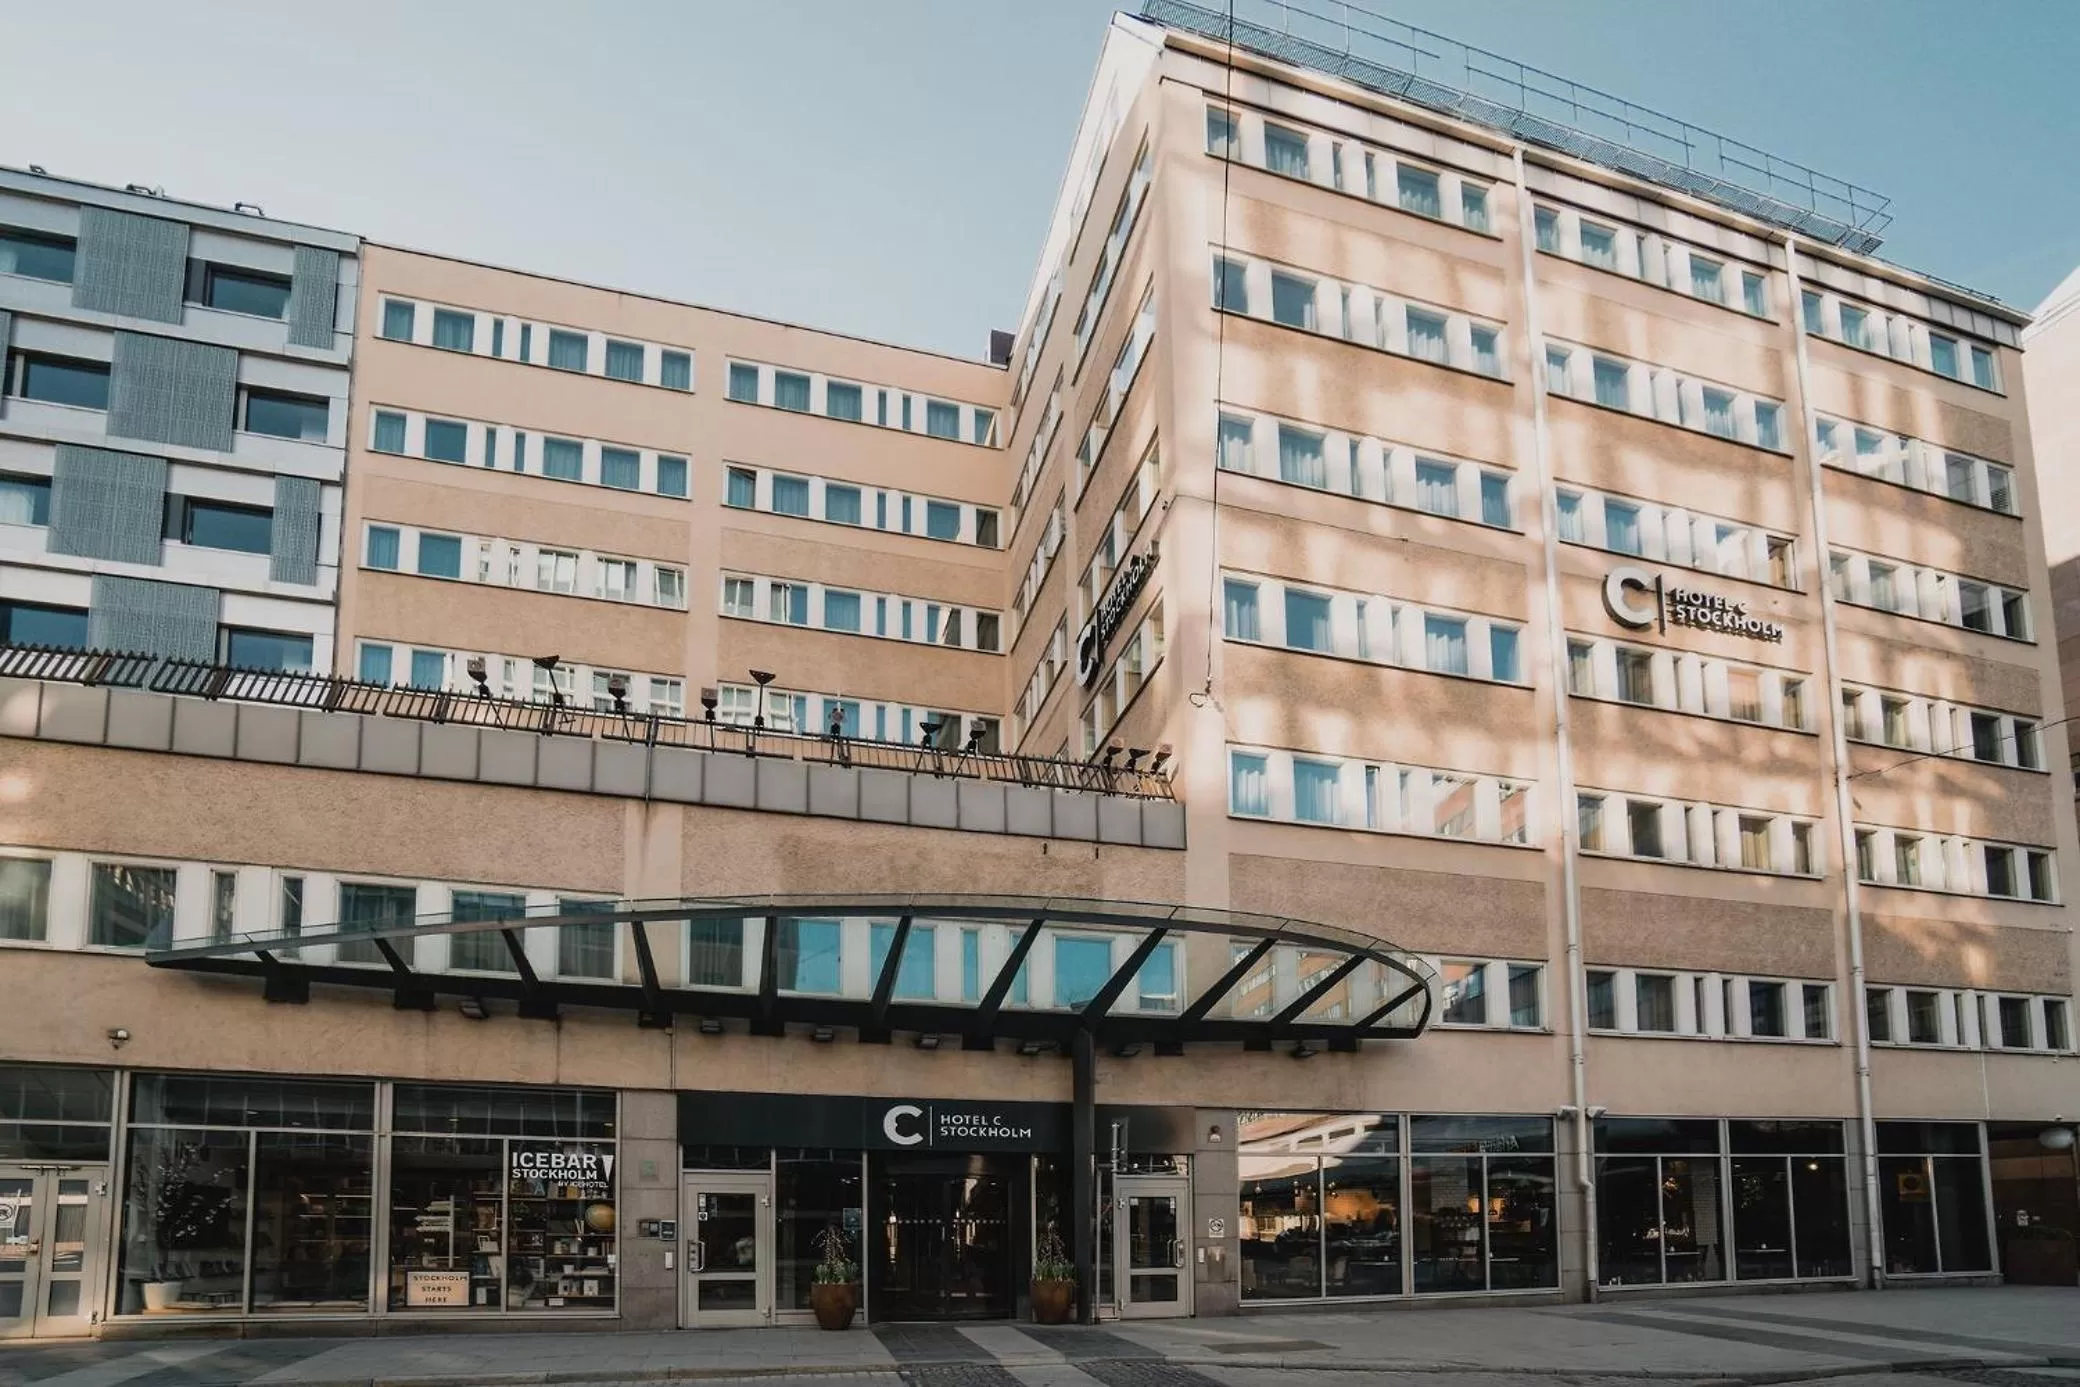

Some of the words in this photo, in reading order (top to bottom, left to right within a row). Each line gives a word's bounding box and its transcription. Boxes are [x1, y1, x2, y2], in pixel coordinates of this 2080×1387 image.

[1604, 565, 1656, 626] C
[1675, 588, 1734, 611] HOTEL
[1675, 604, 1785, 638] STOCKHOLM
[1075, 624, 1098, 687] C
[883, 1104, 924, 1146] C
[940, 1114, 988, 1126] HOTEL
[993, 1115, 1002, 1126] C
[940, 1125, 1032, 1139] STOCKHOLM
[512, 1151, 598, 1170] ICEBAR
[512, 1168, 598, 1180] STOCKHOLM
[558, 1180, 570, 1188] BY
